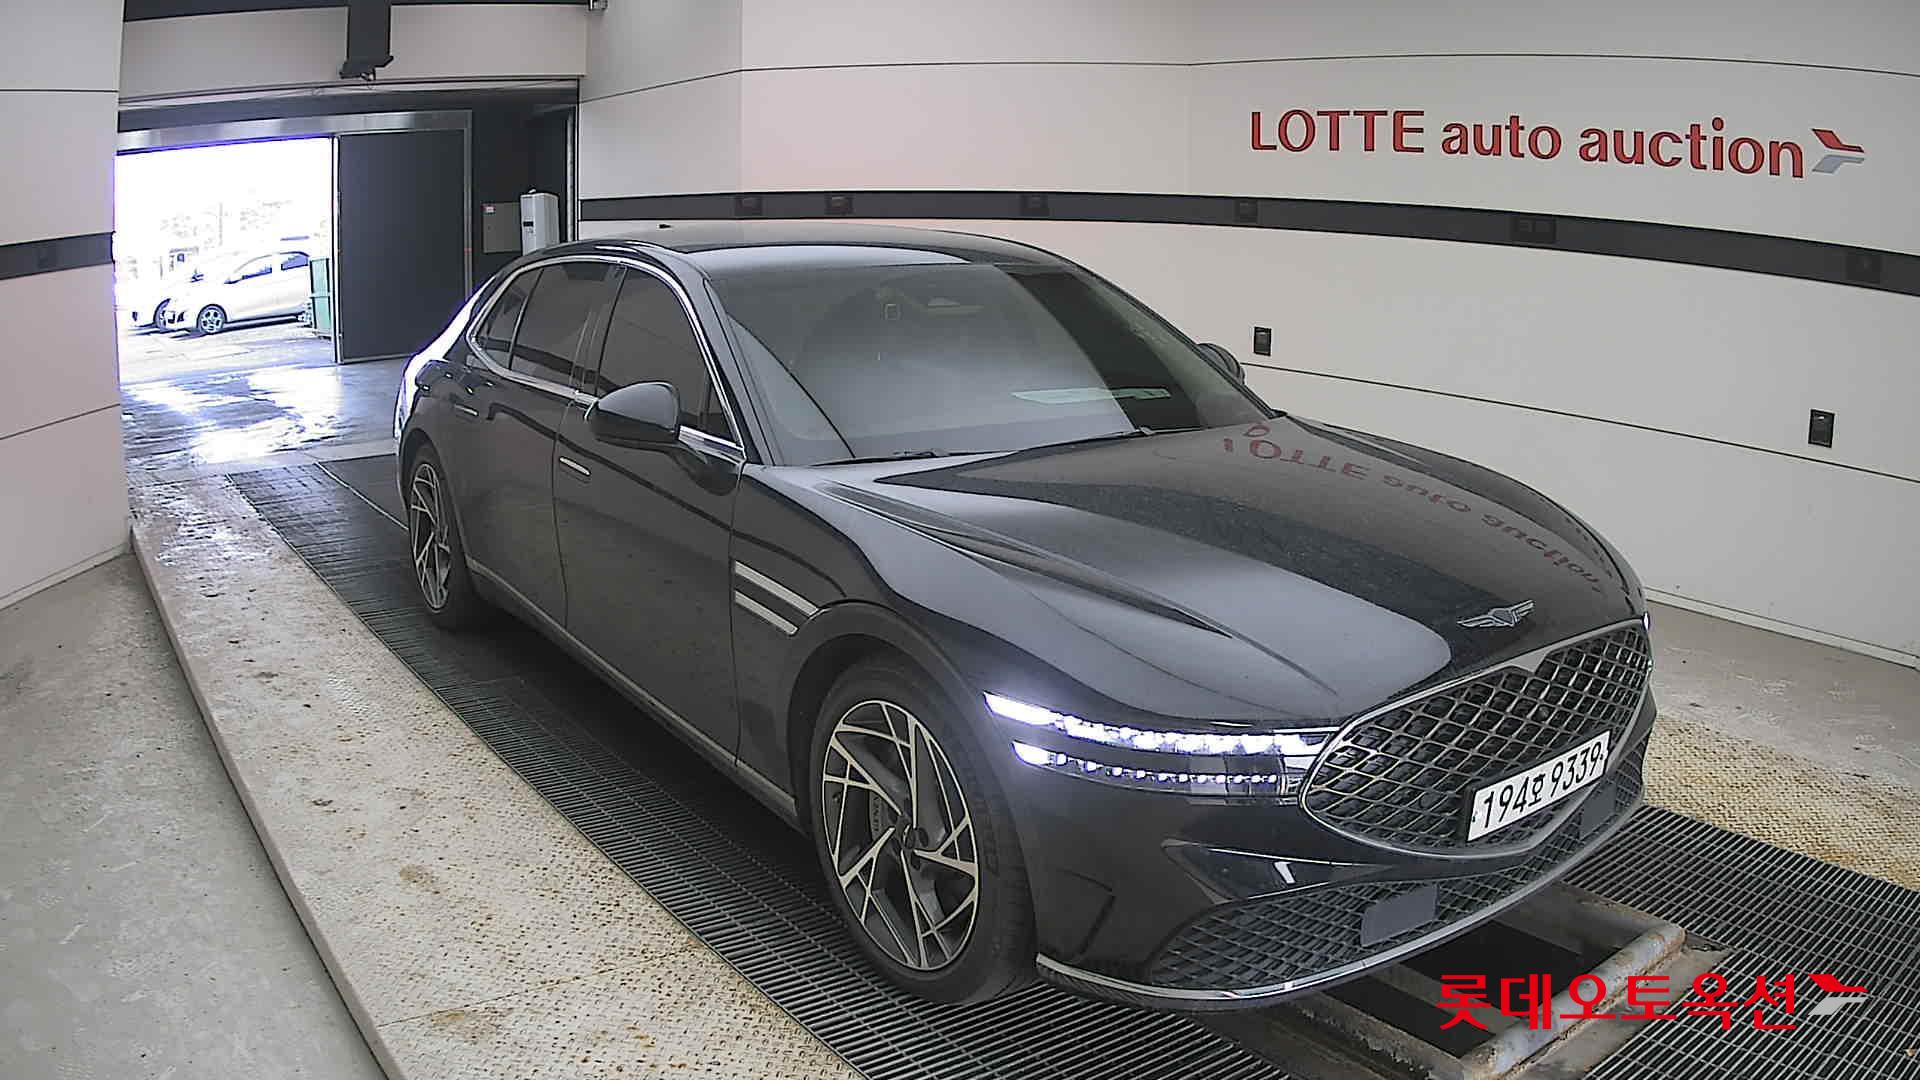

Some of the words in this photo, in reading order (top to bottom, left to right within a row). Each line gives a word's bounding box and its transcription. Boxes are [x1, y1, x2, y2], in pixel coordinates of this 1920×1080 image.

[1251, 110, 1425, 153] LOTTE
[1442, 116, 1562, 160] auto
[1579, 118, 1804, 178] auction
[1484, 774, 1547, 829] 194호
[1550, 742, 1602, 798] 9339
